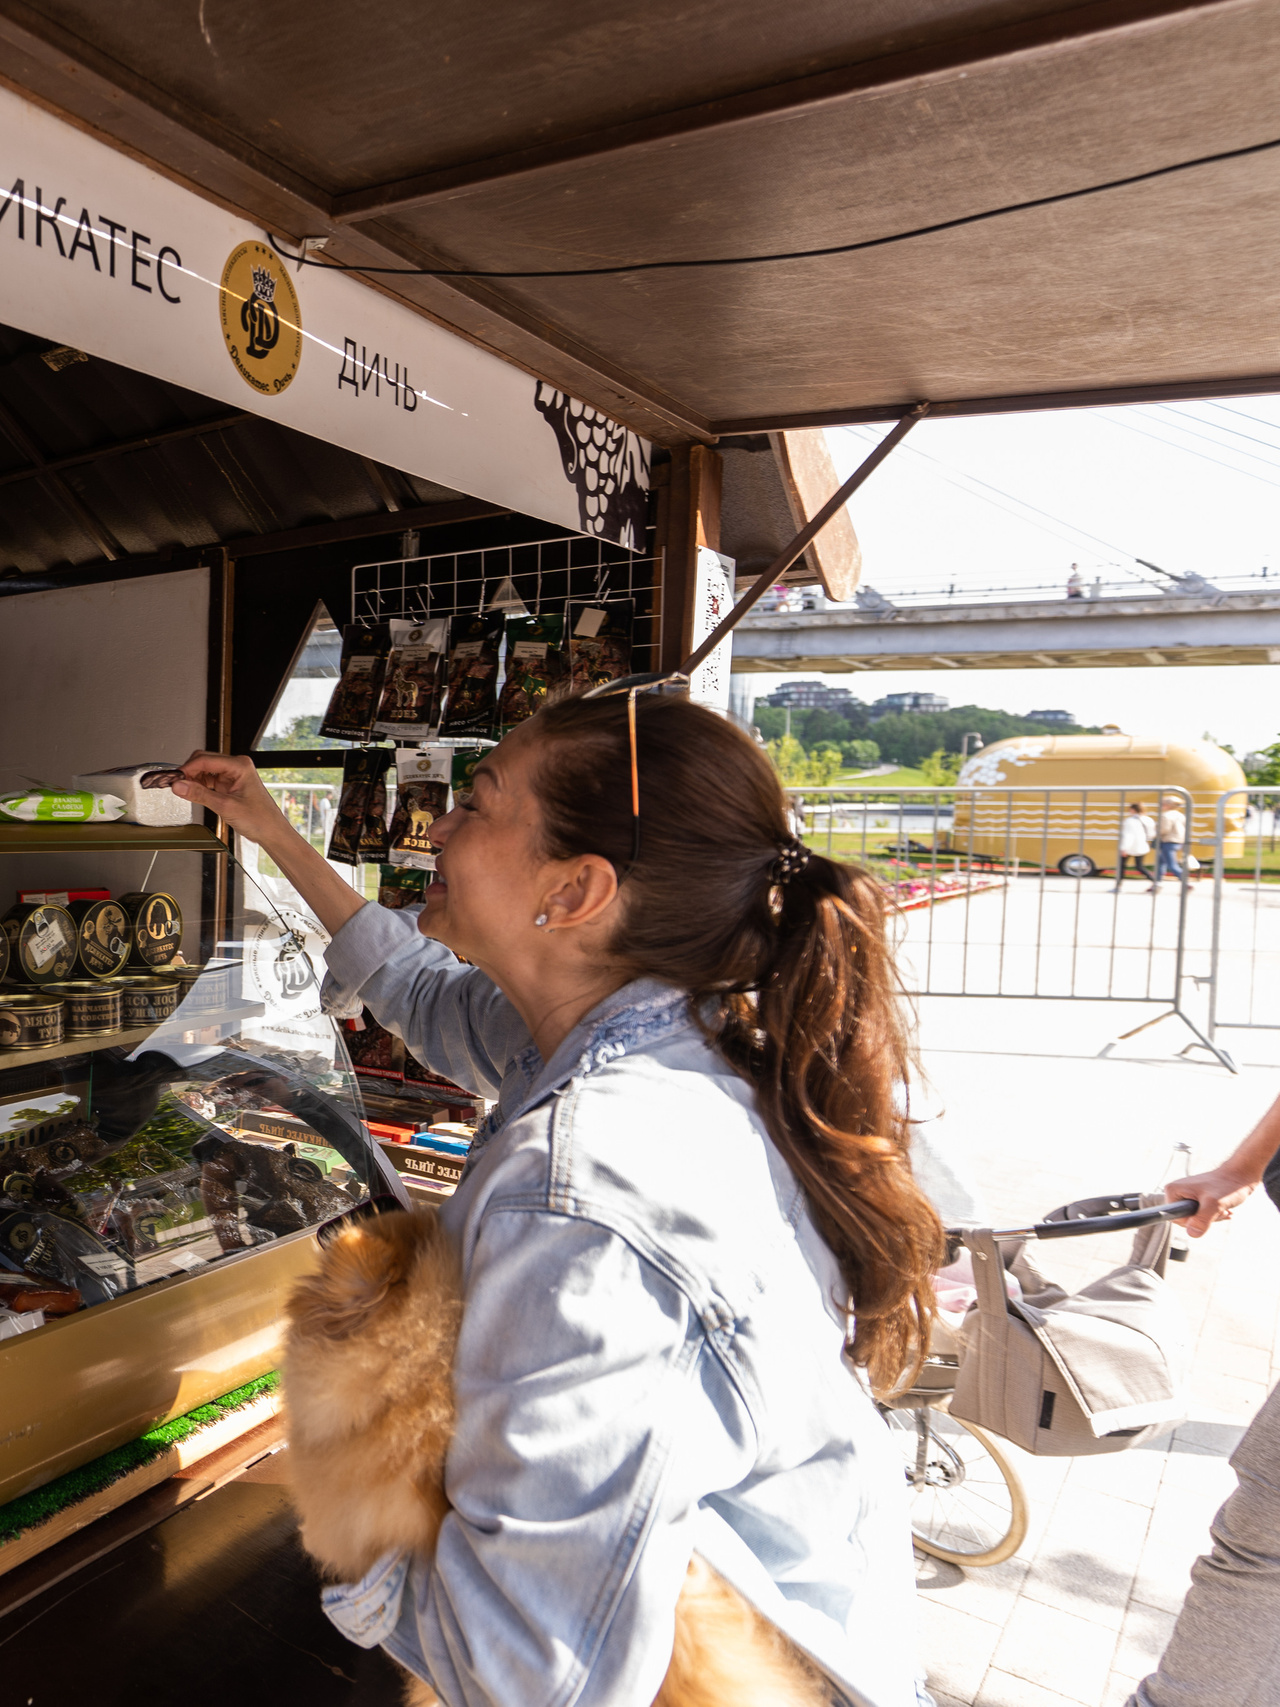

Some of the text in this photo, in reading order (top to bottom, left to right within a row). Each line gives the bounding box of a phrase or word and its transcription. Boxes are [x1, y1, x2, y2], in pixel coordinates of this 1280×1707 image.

[230, 345, 293, 393] Деликатес Дичь
[337, 336, 417, 412] ДИЧЬ
[405, 1157, 435, 1174] ДИЧЬ
